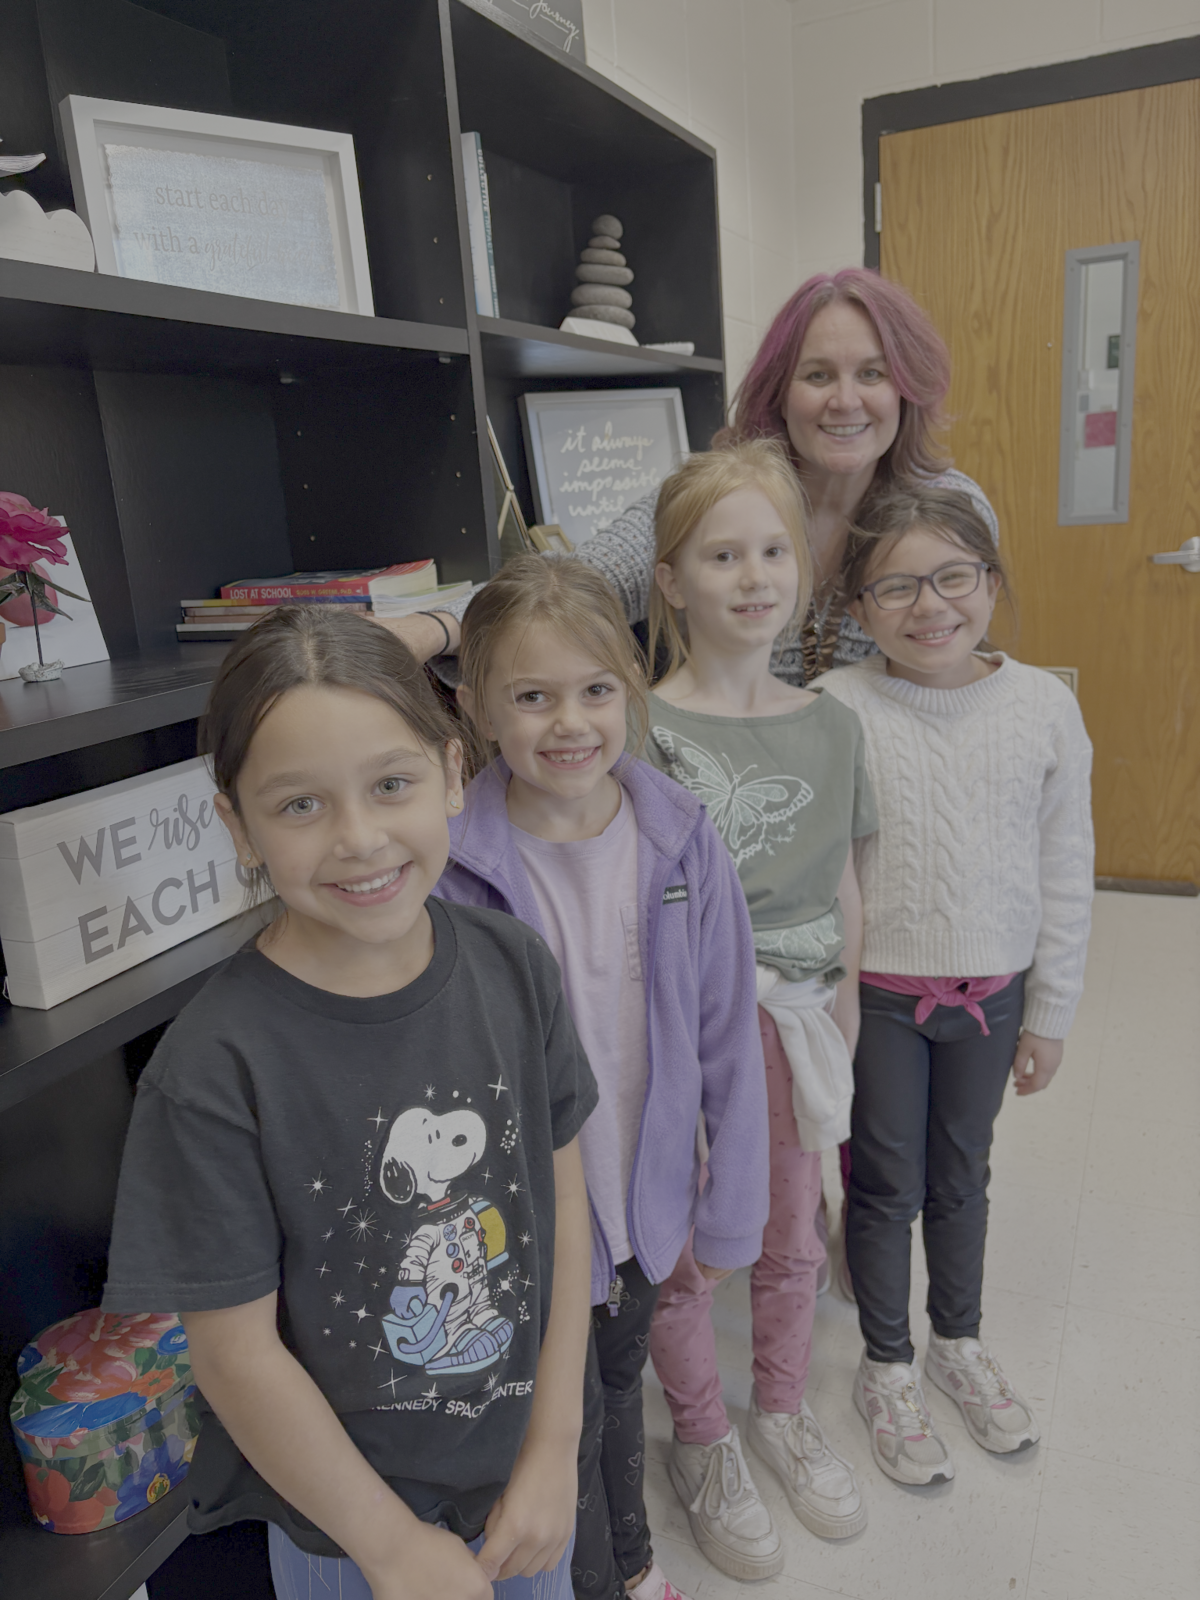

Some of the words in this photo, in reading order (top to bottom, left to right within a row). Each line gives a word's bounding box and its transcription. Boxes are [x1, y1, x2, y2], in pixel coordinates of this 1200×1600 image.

[155, 184, 204, 209] start
[209, 188, 252, 214] each
[257, 191, 288, 226] day
[133, 226, 183, 253] with
[188, 236, 201, 254] a
[205, 233, 272, 271] grateful
[560, 426, 586, 453] it
[592, 421, 654, 460] always
[577, 457, 642, 476] seems
[568, 495, 625, 517] until
[230, 589, 249, 600] LOST
[250, 588, 259, 600] AT
[261, 587, 294, 599] SCHOOL
[56, 816, 142, 885] WE
[147, 793, 215, 851] rise
[663, 889, 687, 899] olumbia
[78, 860, 220, 965] EACH
[371, 1397, 443, 1412] NNEDY
[488, 1379, 534, 1403] ENTER
